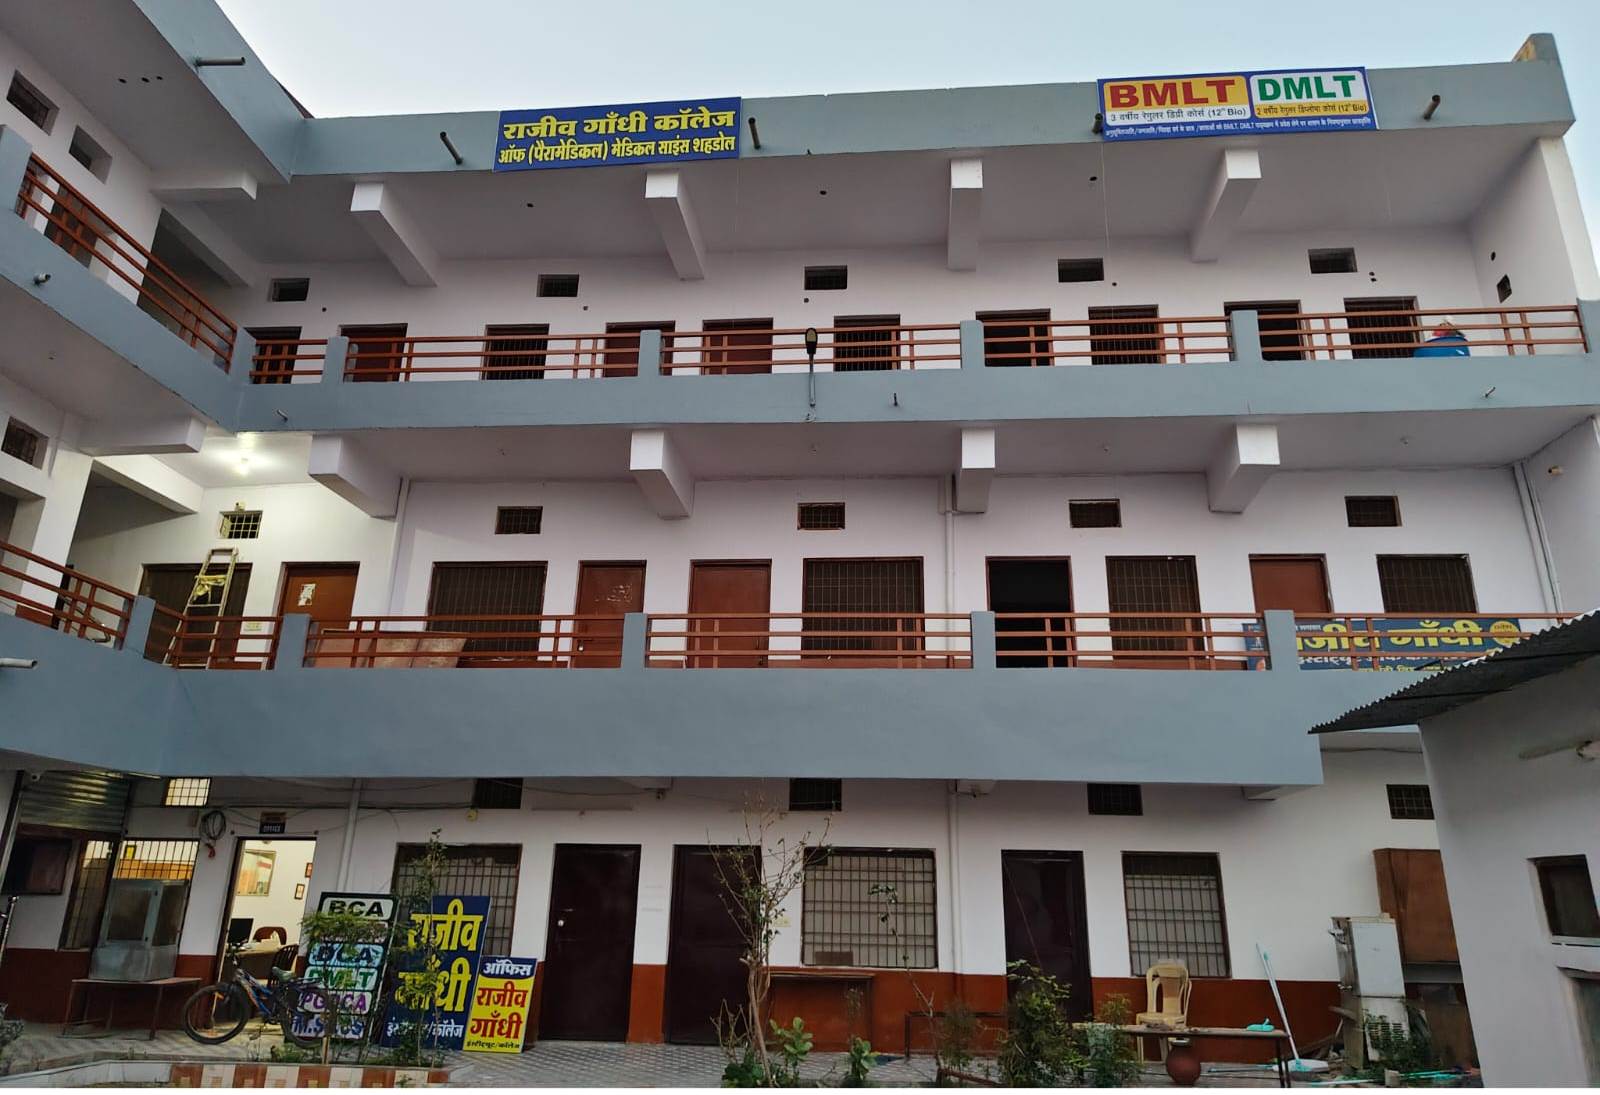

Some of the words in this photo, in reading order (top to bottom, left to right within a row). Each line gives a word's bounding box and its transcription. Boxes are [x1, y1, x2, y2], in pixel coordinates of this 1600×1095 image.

[1109, 79, 1235, 109] BMLT
[1256, 75, 1356, 101] DMLT
[503, 115, 578, 139] राजीव
[583, 110, 649, 135] गाँधी
[654, 106, 736, 131] कॉलेज
[498, 144, 526, 164] ऑफ
[528, 138, 608, 165] (पैरामेडिकल)
[611, 137, 656, 157] मेडिकल
[658, 134, 690, 155] साइंस
[693, 131, 736, 154] शहडोल
[328, 900, 384, 918] BCA
[408, 899, 484, 951] राजीव
[483, 959, 533, 976] ऑफिस
[477, 981, 529, 1008] राजीव
[470, 1010, 523, 1039] गाँधी
